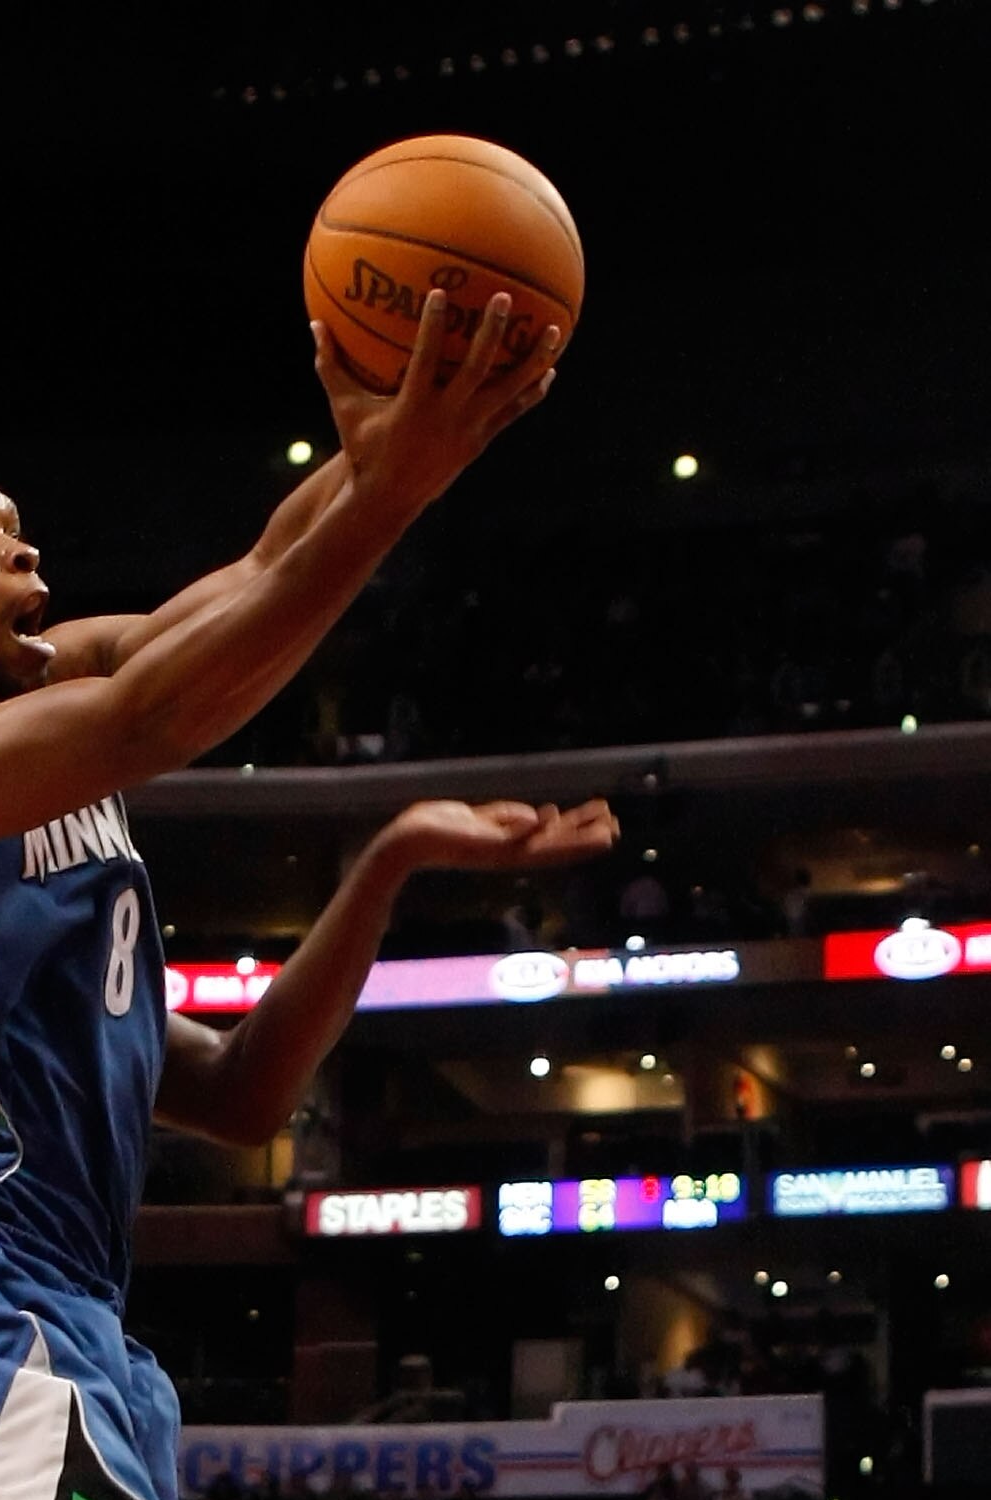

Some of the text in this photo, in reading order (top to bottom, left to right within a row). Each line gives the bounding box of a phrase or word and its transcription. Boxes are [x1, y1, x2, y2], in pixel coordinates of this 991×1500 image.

[105, 888, 141, 1016] 8
[774, 1168, 944, 1197] SAN MANUEL
[319, 1190, 467, 1235] STAPLES
[183, 1438, 498, 1492] CLIPPERS
